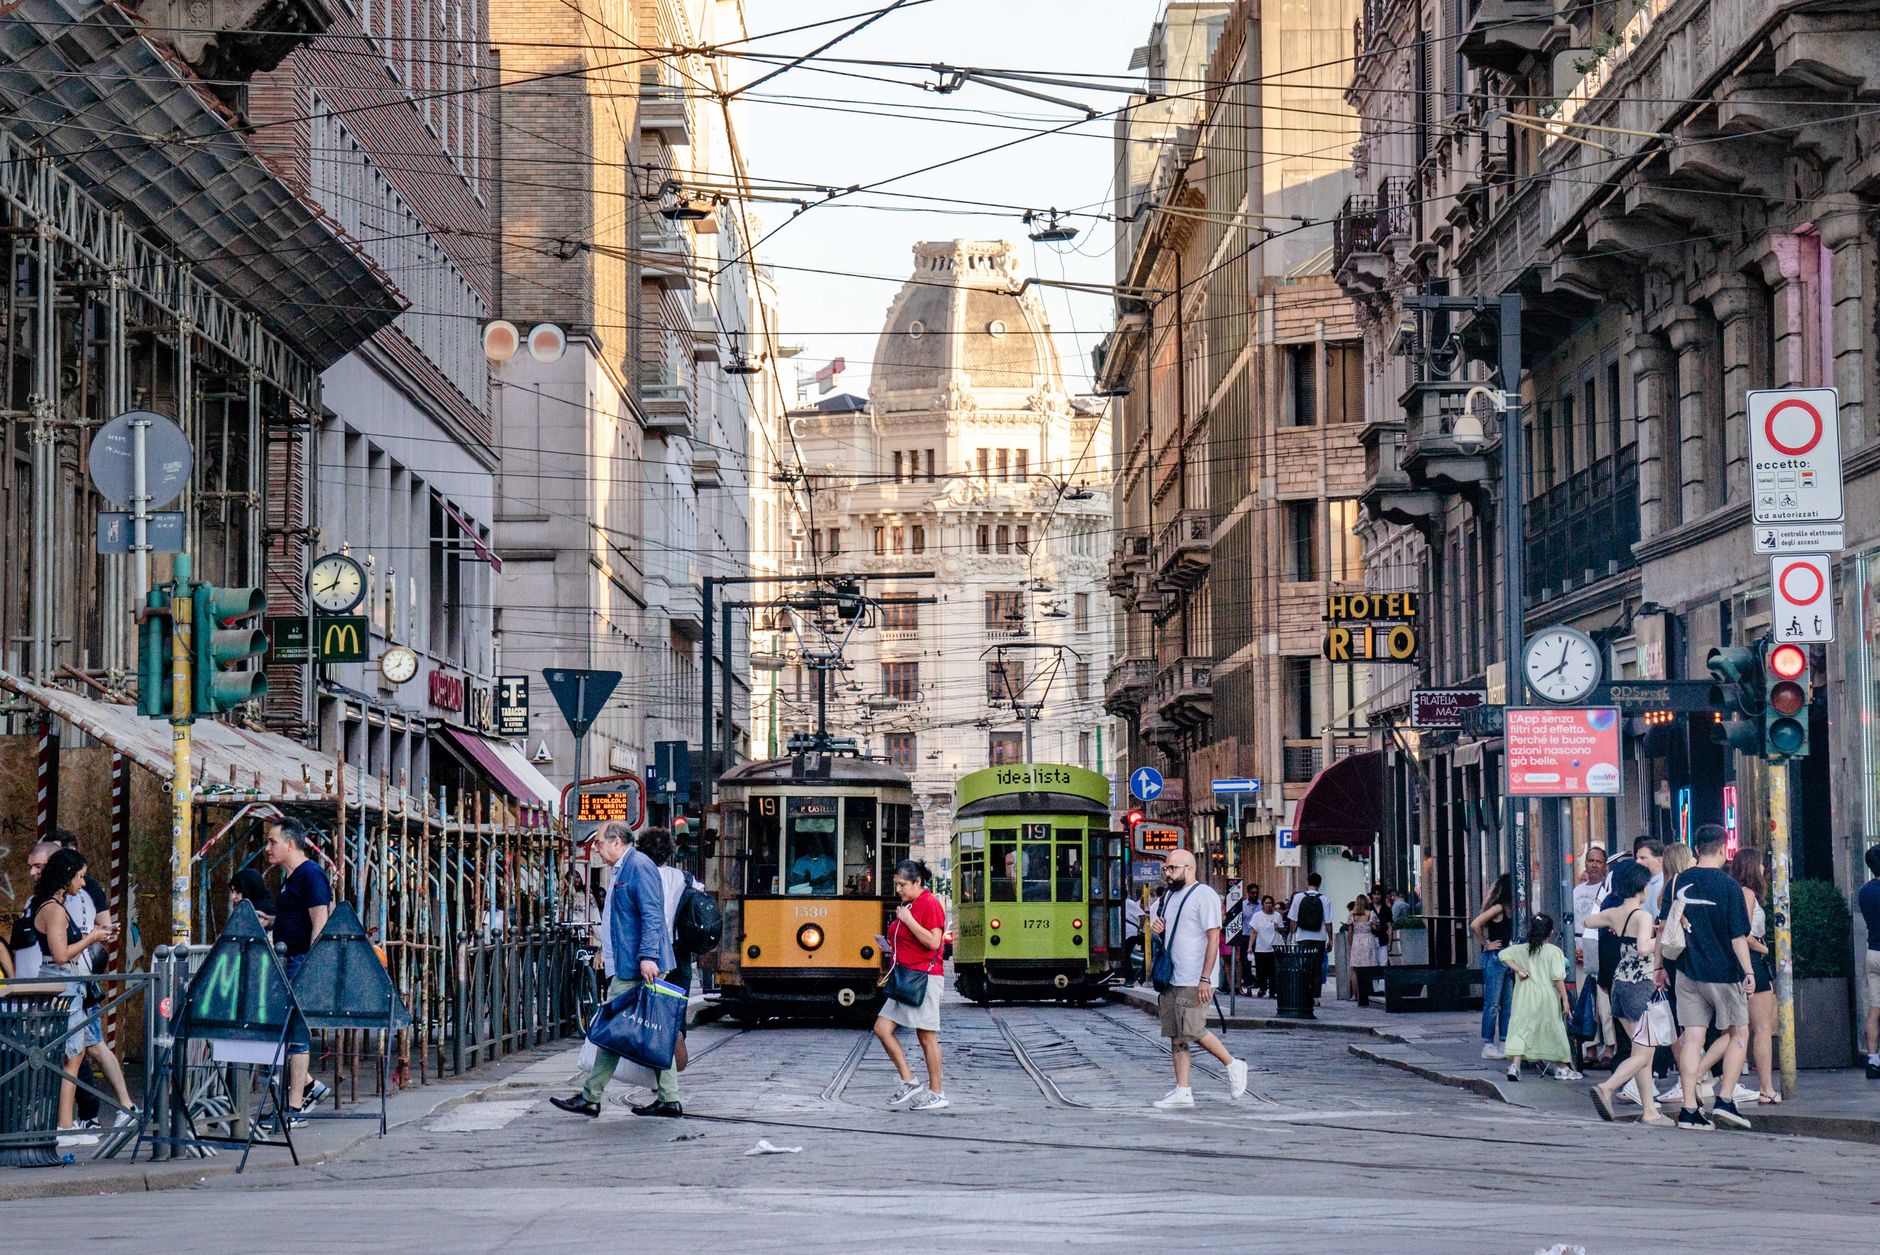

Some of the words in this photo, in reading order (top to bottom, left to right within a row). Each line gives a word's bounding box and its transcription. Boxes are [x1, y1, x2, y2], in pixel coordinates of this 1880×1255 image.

[1756, 460, 1810, 469] eccetto:
[1330, 592, 1415, 619] HOTEL
[1330, 625, 1415, 660] RIO
[1420, 696, 1457, 705] FILATELIA
[501, 707, 527, 716] TABACCHI
[1510, 715, 1539, 725] L'App
[1510, 725, 1530, 734] filtri
[1533, 725, 1547, 734] ad
[1550, 725, 1586, 734] effetto.
[1510, 735, 1547, 744] Perché
[1550, 736, 1559, 744] le
[1562, 736, 1596, 744] buone
[1511, 747, 1541, 755] azioni
[1511, 756, 1527, 767] già
[1530, 757, 1558, 765] belle.
[997, 769, 1070, 784] idealista
[759, 798, 775, 816] 19
[1028, 824, 1046, 839] 19
[1024, 920, 1050, 928] 1773
